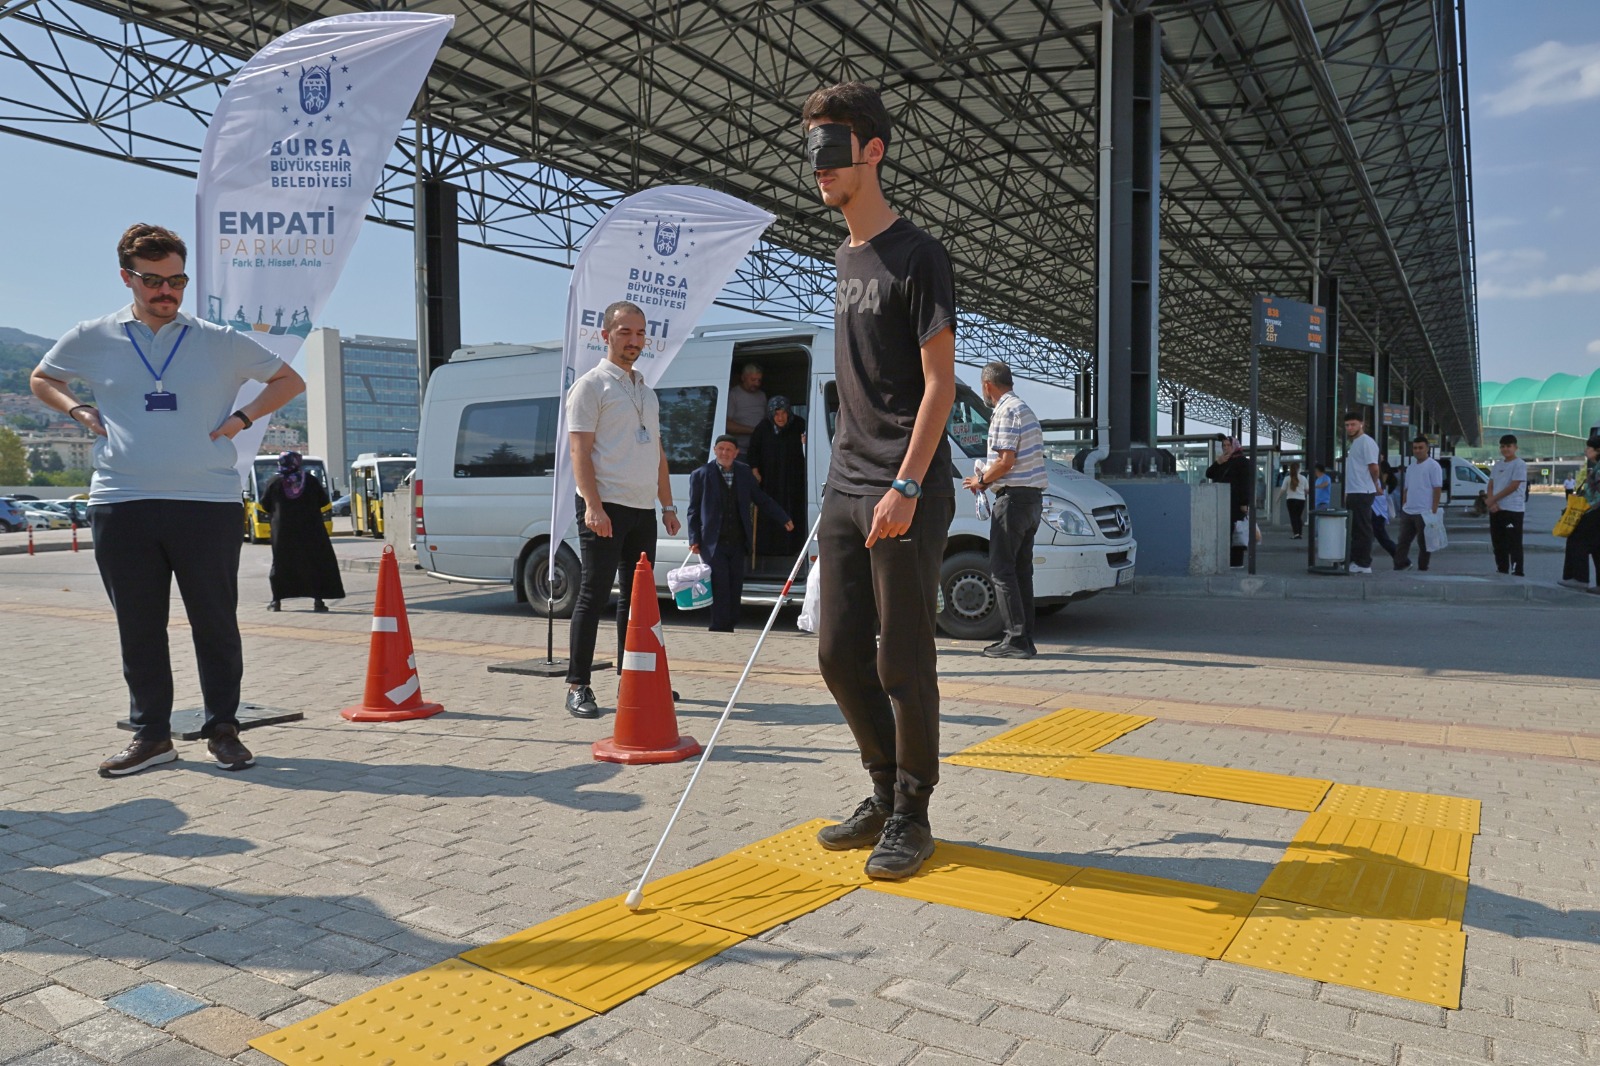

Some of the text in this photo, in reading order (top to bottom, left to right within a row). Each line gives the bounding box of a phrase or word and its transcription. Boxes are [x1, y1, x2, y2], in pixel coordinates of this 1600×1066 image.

[270, 138, 352, 156] BURSA
[271, 173, 352, 188] BELEDİYESİ
[219, 206, 334, 235] EMPATİ
[219, 238, 335, 256] PARKURU
[232, 258, 252, 268] Fark
[300, 257, 322, 268] Anla
[629, 267, 688, 290] BURSA
[626, 292, 686, 311] BELEDİYESİ
[581, 309, 670, 338] ETİ
[579, 327, 667, 352] PARU
[586, 343, 602, 351] Fark
